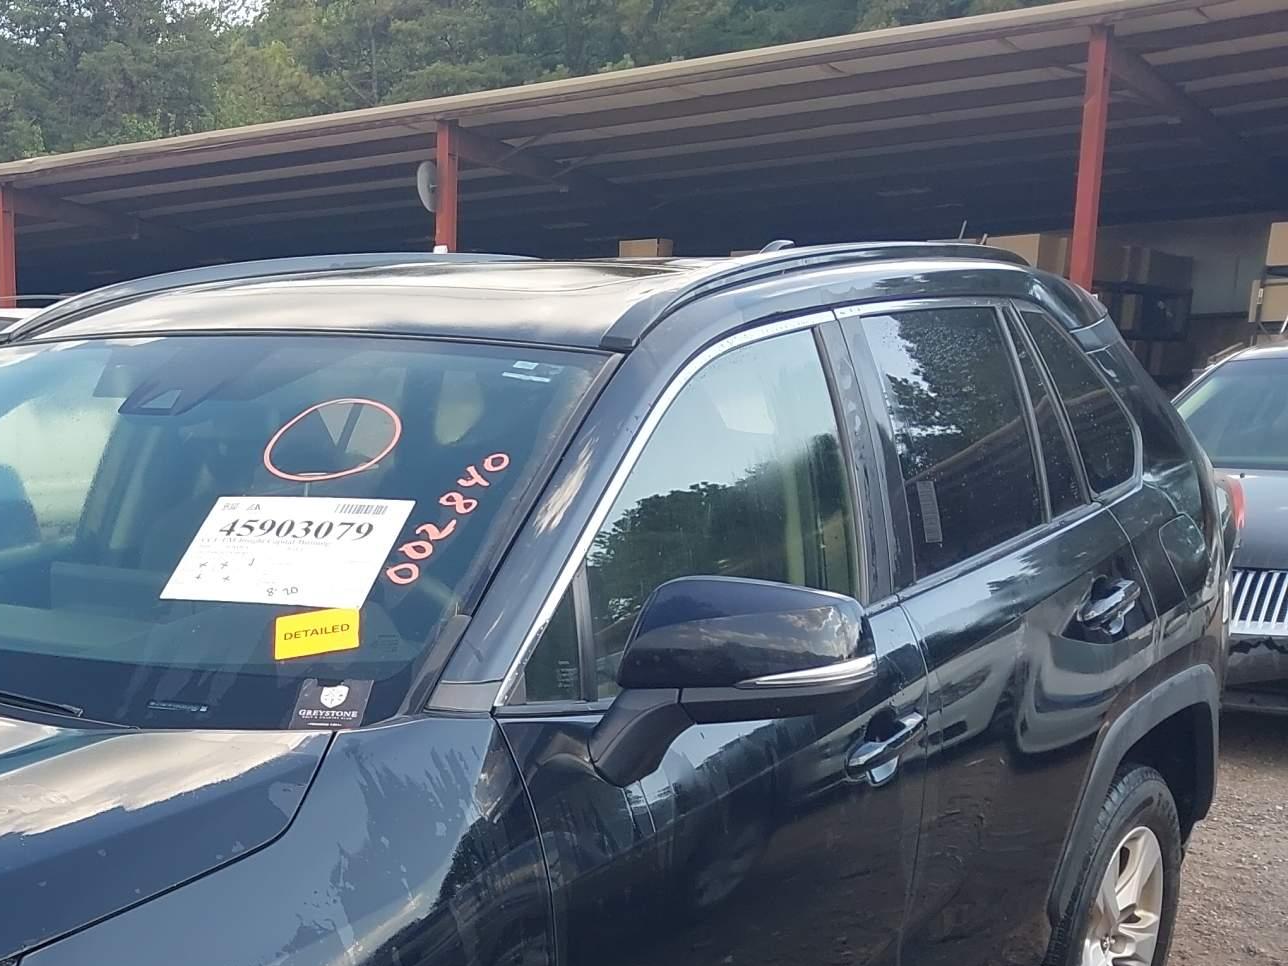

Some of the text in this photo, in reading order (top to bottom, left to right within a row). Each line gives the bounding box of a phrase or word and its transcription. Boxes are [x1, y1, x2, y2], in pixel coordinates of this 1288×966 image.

[385, 453, 510, 585] 002840
[219, 518, 374, 541] 45903079
[283, 623, 350, 641] DETAILED
[298, 709, 358, 718] GREYSTONE
